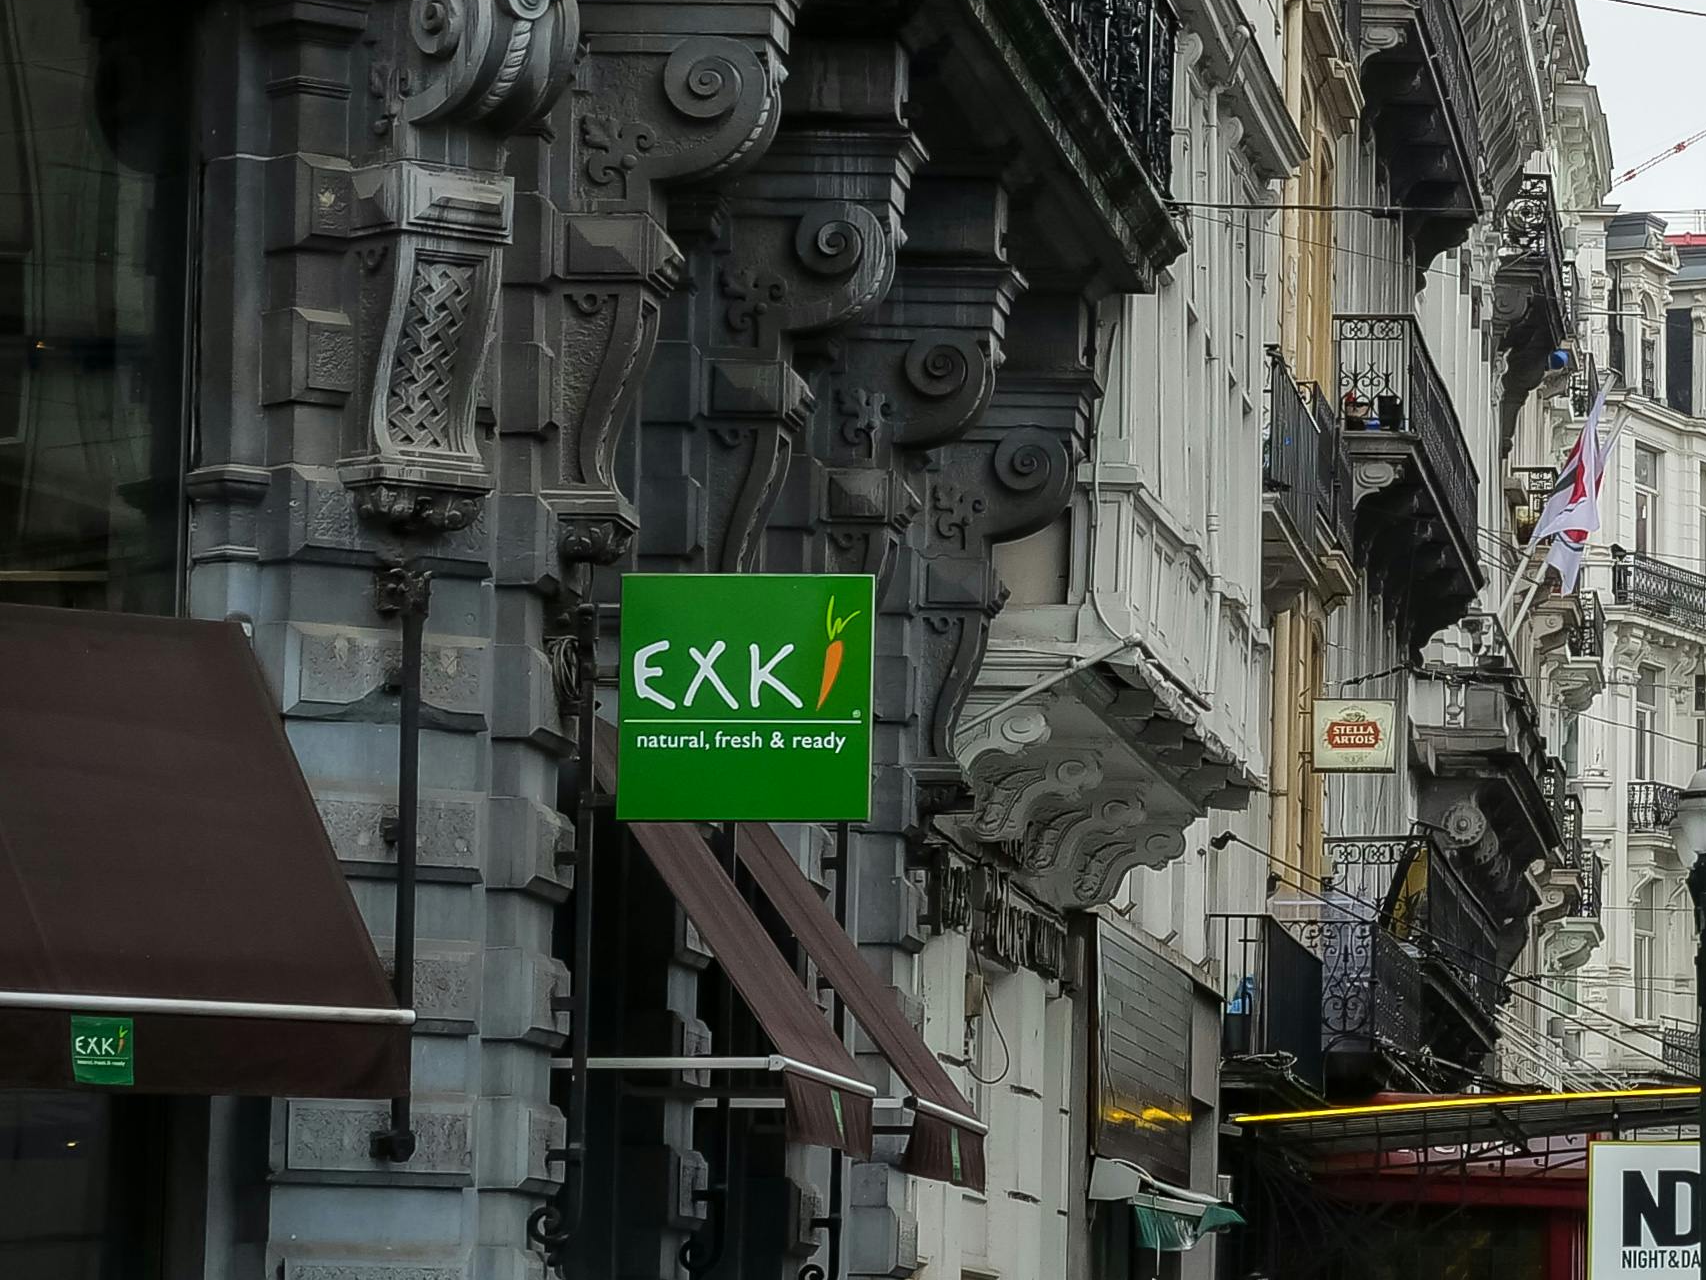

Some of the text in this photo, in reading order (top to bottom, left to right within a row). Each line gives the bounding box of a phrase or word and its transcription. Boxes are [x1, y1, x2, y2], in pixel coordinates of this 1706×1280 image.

[1333, 726, 1374, 734] STELLA
[636, 731, 846, 753] natural, fresh & ready
[1333, 735, 1375, 744] ARTOIS
[1622, 1250, 1701, 1269] NIGHT&DA
